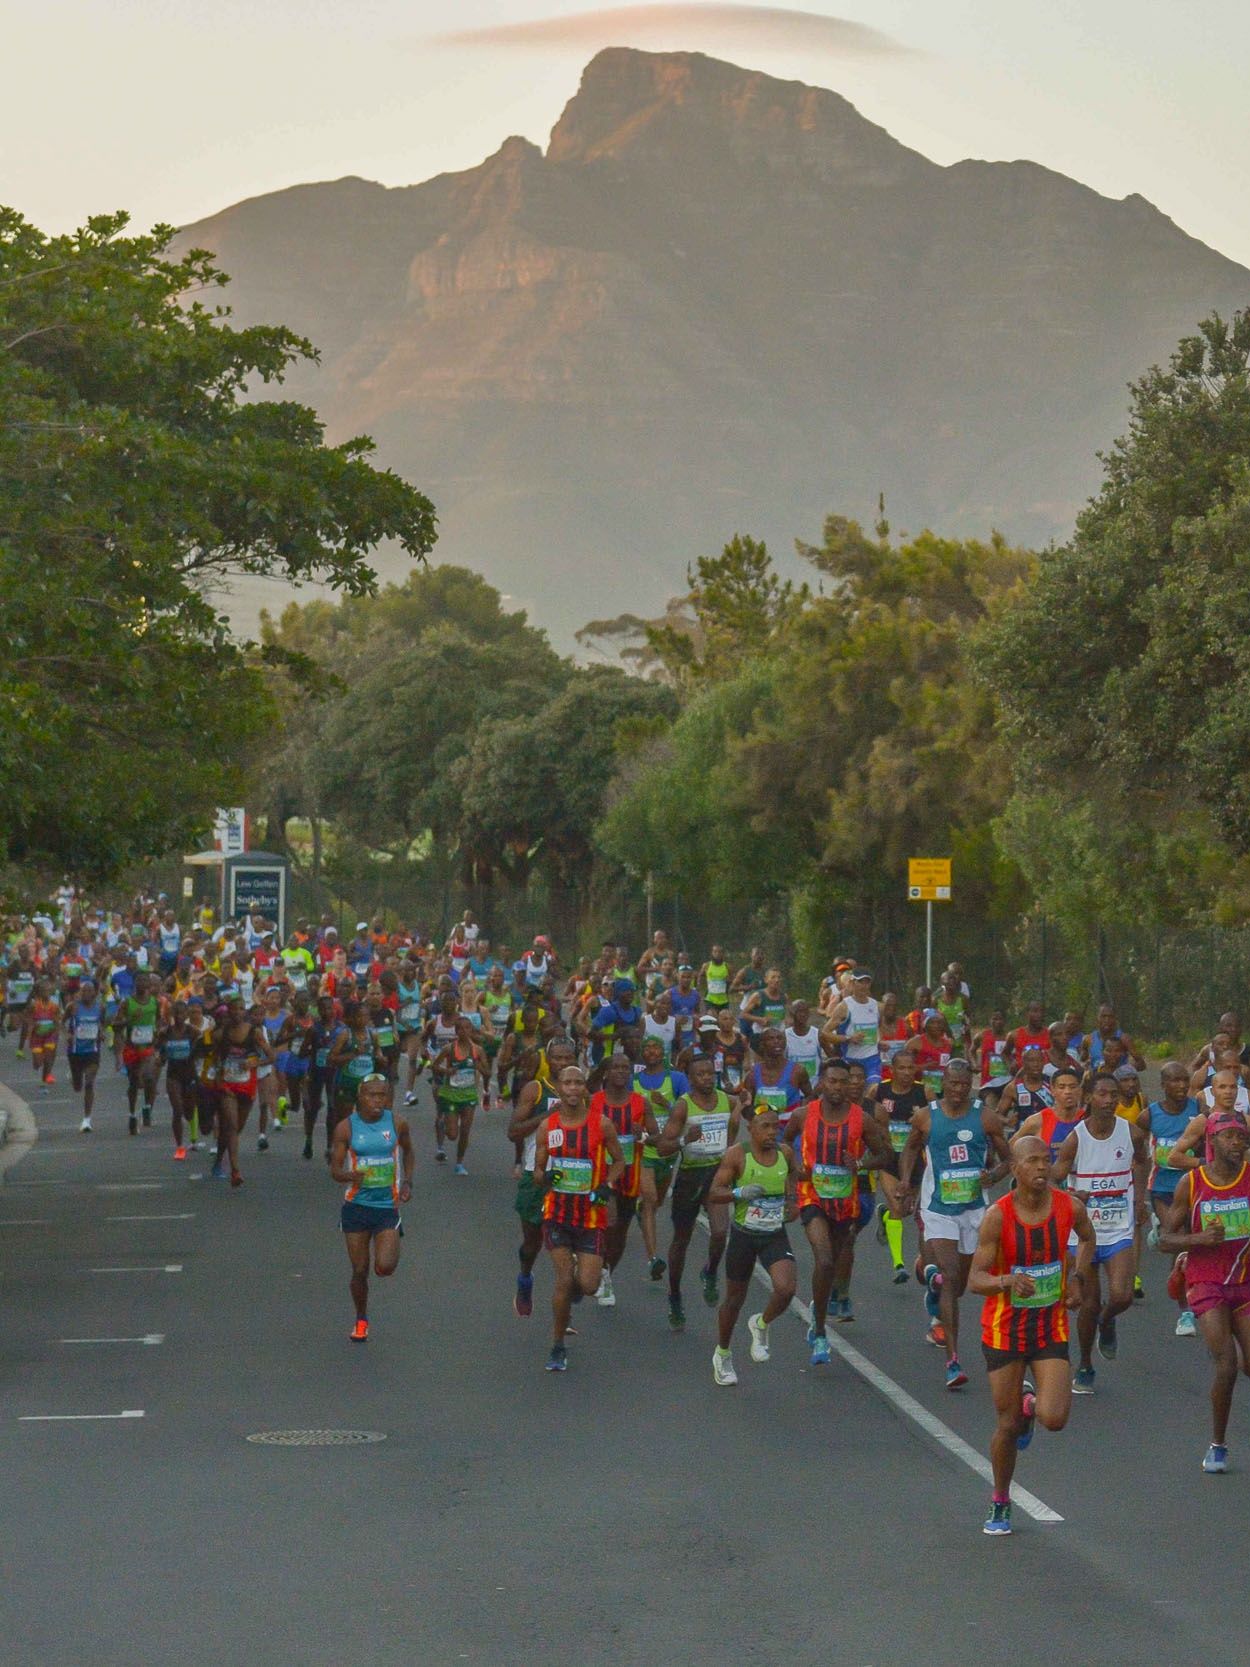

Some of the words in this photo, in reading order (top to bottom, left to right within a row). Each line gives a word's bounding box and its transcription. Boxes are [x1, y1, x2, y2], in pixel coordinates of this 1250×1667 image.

[951, 1146, 967, 1161] 45
[1091, 1179, 1117, 1190] EGA
[1213, 1201, 1249, 1212] Sanlam
[1091, 1208, 1123, 1221] A871
[1025, 1264, 1061, 1278] Sanlam
